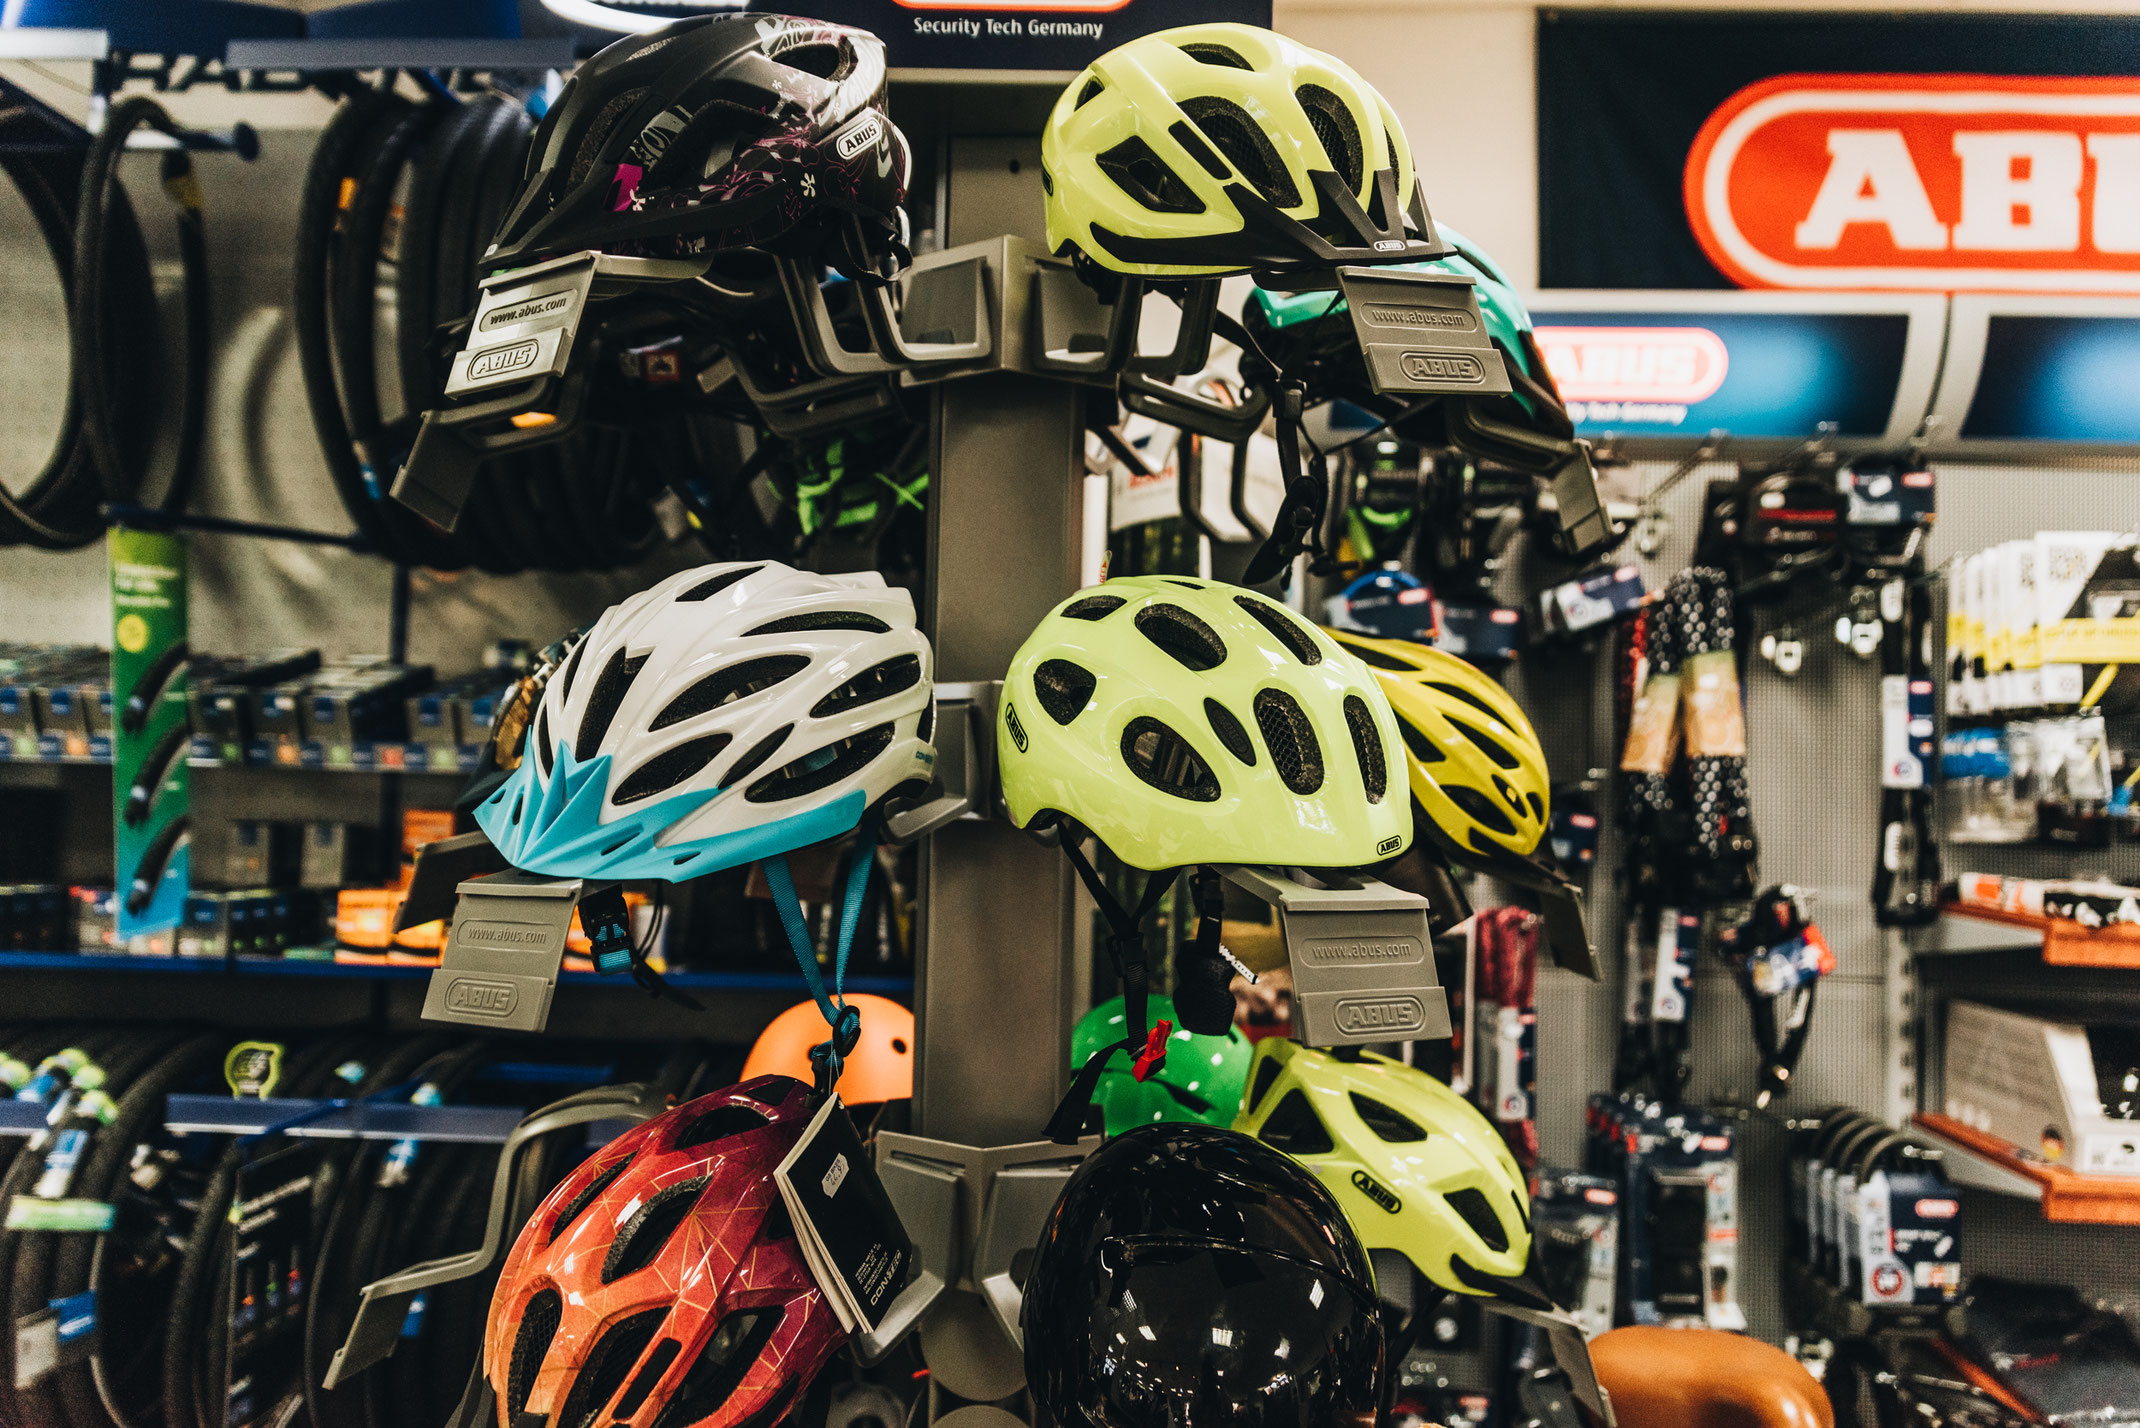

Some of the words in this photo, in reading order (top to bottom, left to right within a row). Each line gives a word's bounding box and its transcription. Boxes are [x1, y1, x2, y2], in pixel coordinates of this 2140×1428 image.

[913, 17, 981, 38] Security
[985, 18, 1023, 36] Tech
[1028, 19, 1104, 40] Germany
[845, 123, 877, 153] ABUS
[1379, 242, 1402, 250] ABUS
[490, 297, 567, 325] www.abus.com
[1372, 310, 1465, 327] www.abus.com
[476, 346, 532, 375] ABUS
[1413, 358, 1475, 378] ABUS
[1546, 344, 1696, 386] ABUS
[1007, 710, 1025, 748] ABUS
[1380, 838, 1400, 853] ABUS
[467, 927, 547, 945] www.abus.com
[1312, 942, 1412, 961] www.abus.com
[455, 985, 511, 1010] ABUS
[1347, 1003, 1414, 1028] ABUS
[1358, 1177, 1397, 1209] ABUS
